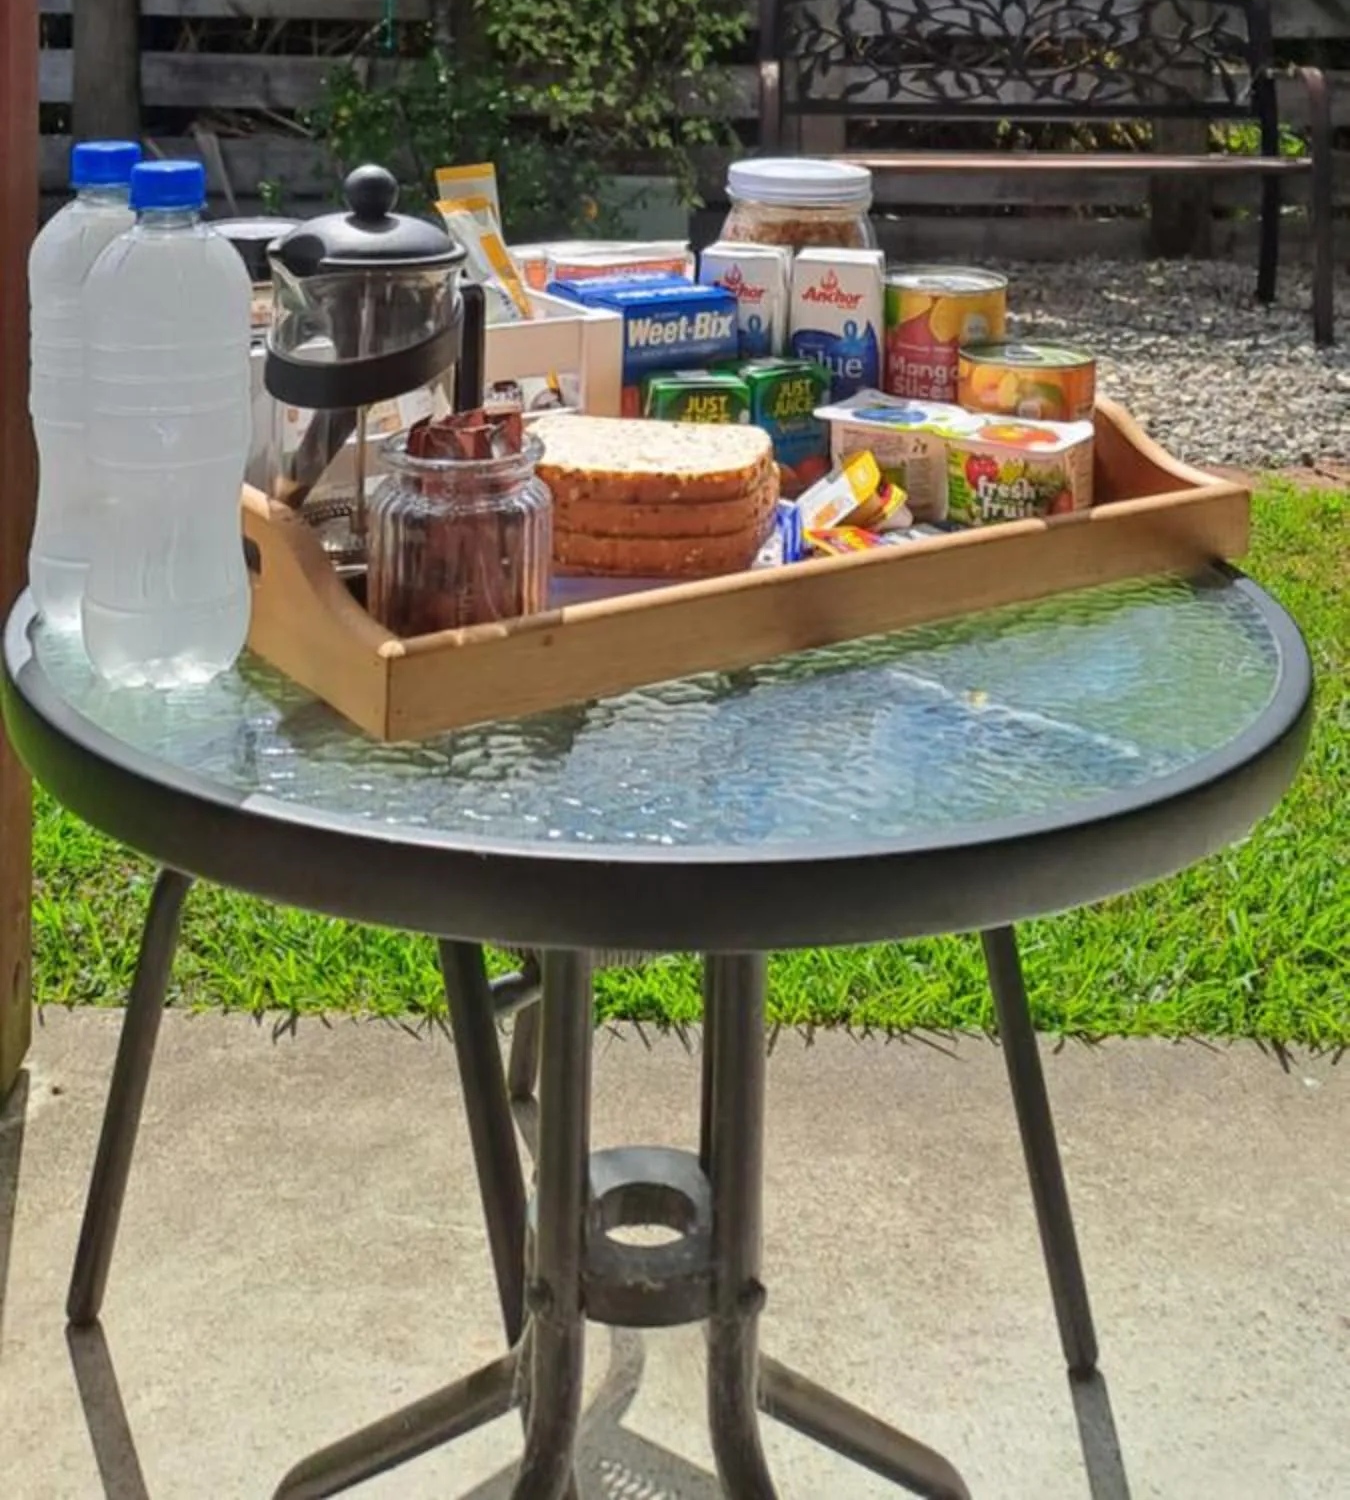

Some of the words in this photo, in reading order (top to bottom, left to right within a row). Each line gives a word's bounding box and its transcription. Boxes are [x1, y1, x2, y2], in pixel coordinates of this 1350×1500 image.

[802, 286, 865, 306] Anchor
[627, 310, 733, 348] Weet-Bix
[779, 379, 812, 398] JUST
[686, 395, 729, 413] JUST
[977, 475, 1036, 500] fresh
[982, 497, 1035, 519] fruit
